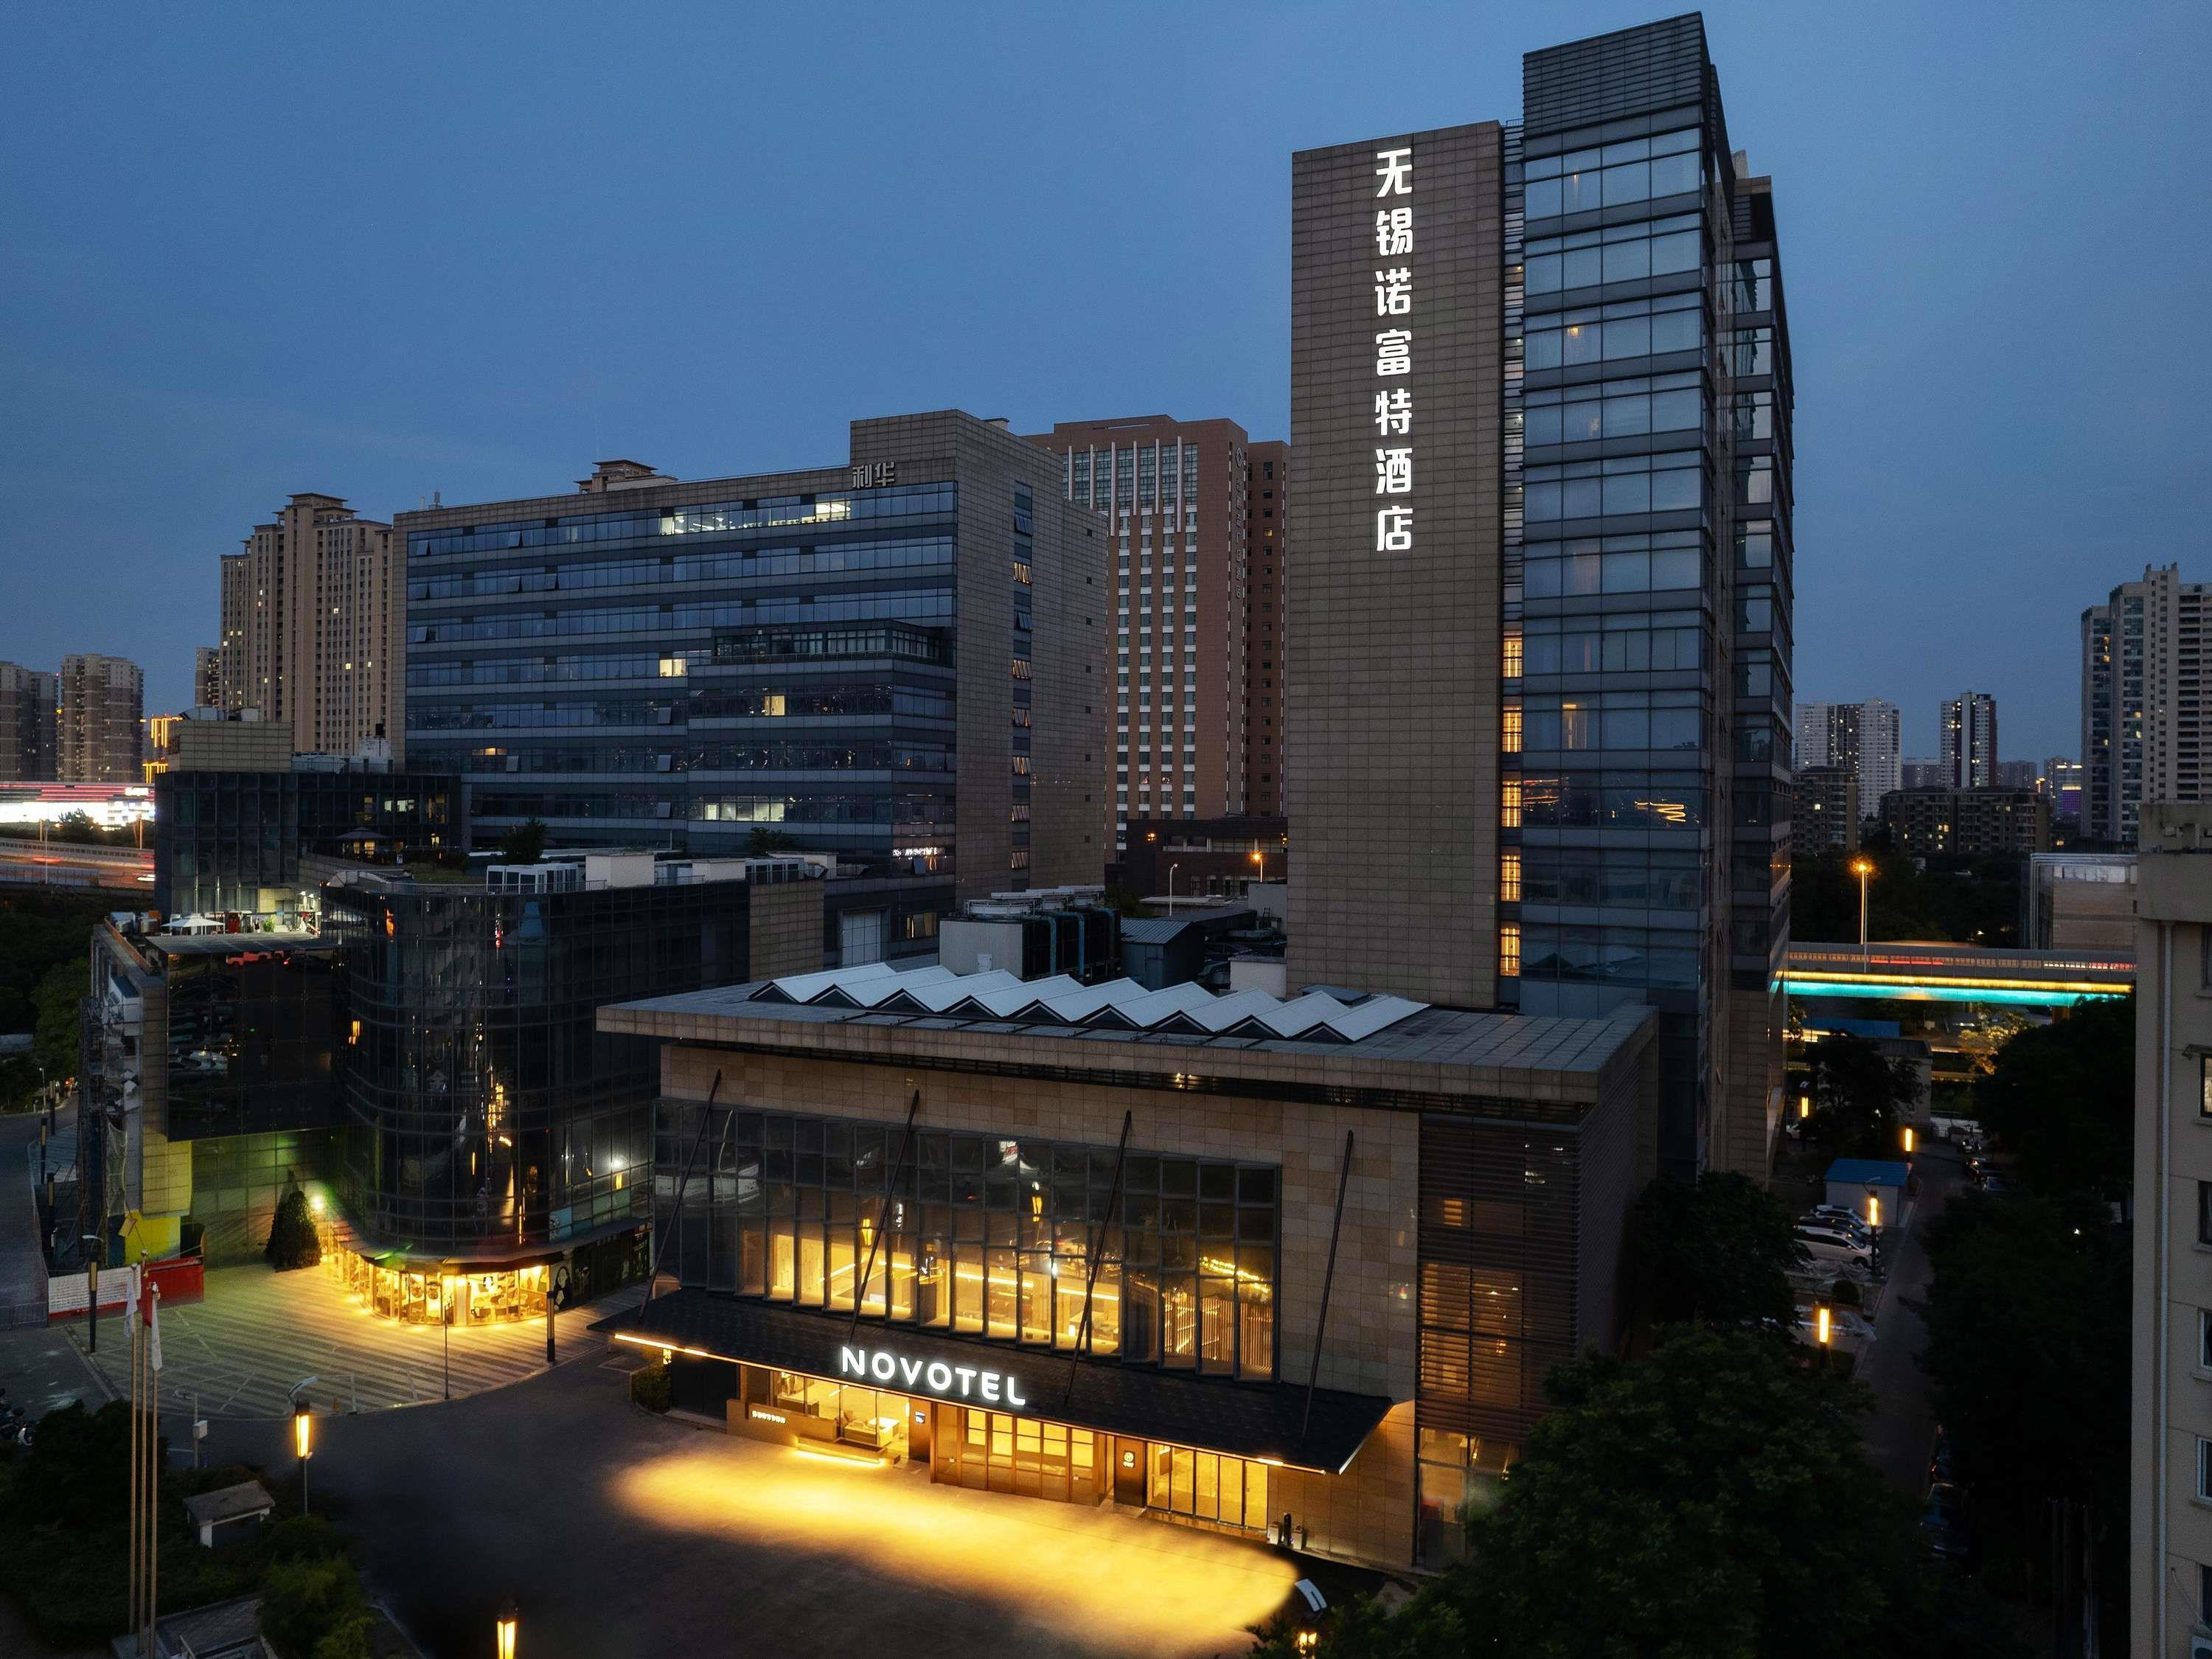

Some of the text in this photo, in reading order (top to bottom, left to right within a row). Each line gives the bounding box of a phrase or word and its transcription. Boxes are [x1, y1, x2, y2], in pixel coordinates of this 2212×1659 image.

[1375, 147, 1413, 552] 无锡诺富特酒店
[852, 461, 895, 489] 利华
[841, 1346, 1026, 1406] NOVOTEL
